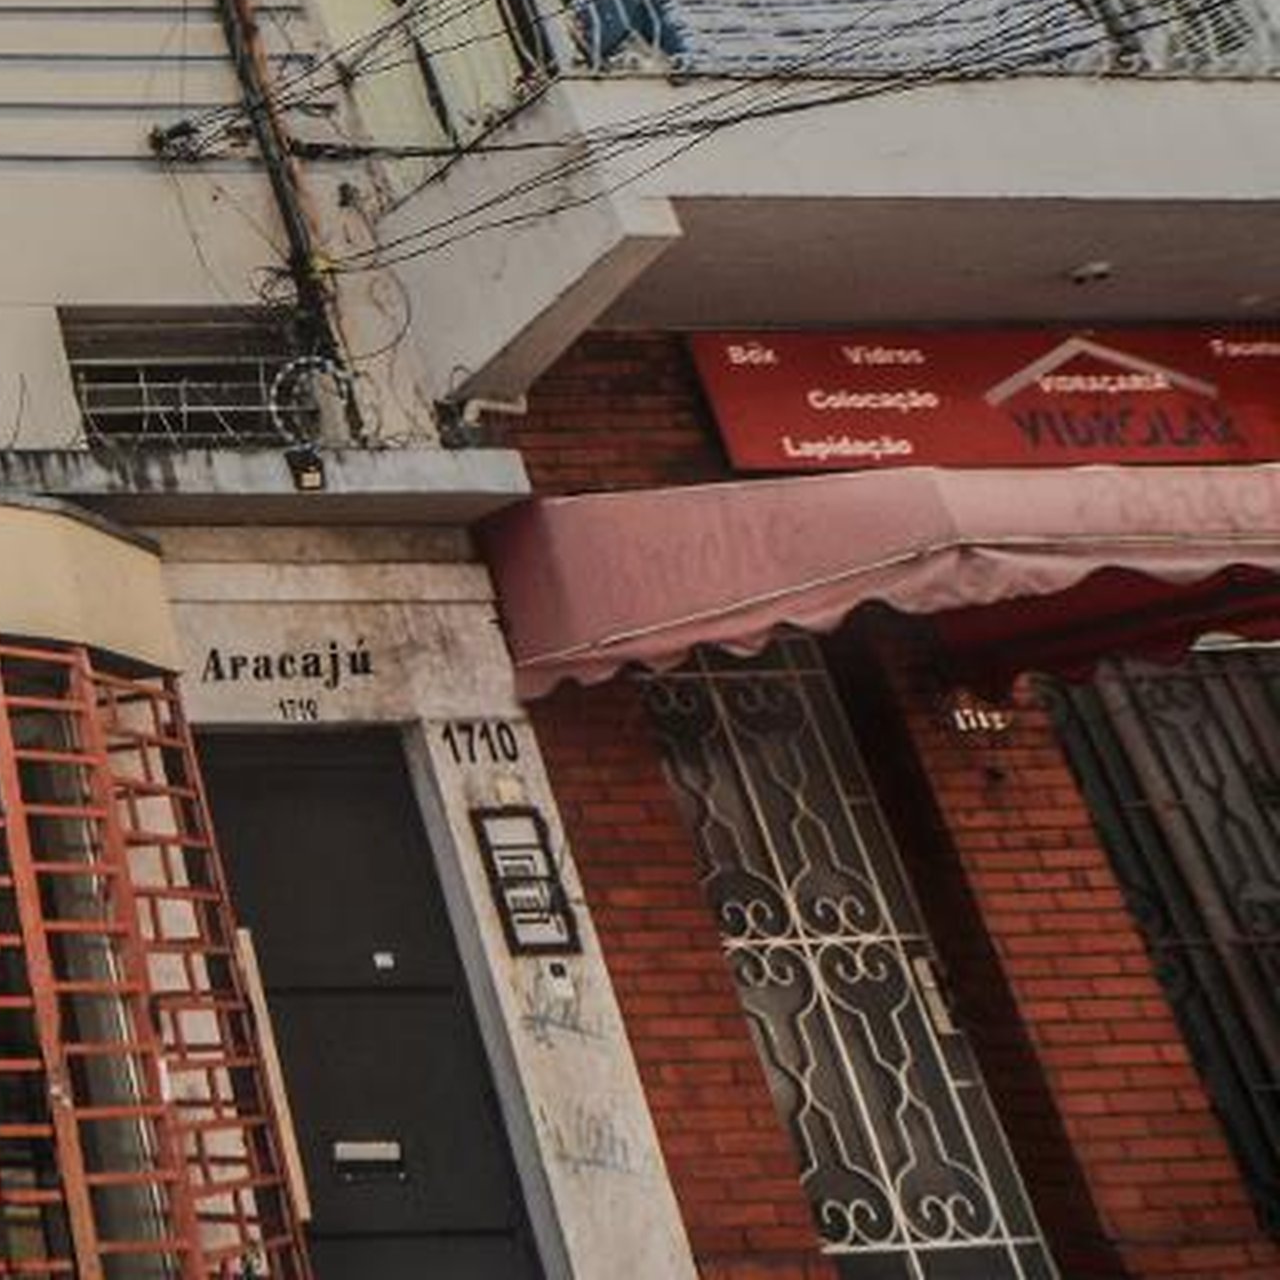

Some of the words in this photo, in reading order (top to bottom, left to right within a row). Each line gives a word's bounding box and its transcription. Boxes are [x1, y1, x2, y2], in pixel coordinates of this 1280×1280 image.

[807, 389, 938, 413] Colocação
[782, 435, 913, 460] Lapidação
[201, 639, 375, 689] Aracajú
[441, 721, 520, 764] 1710
